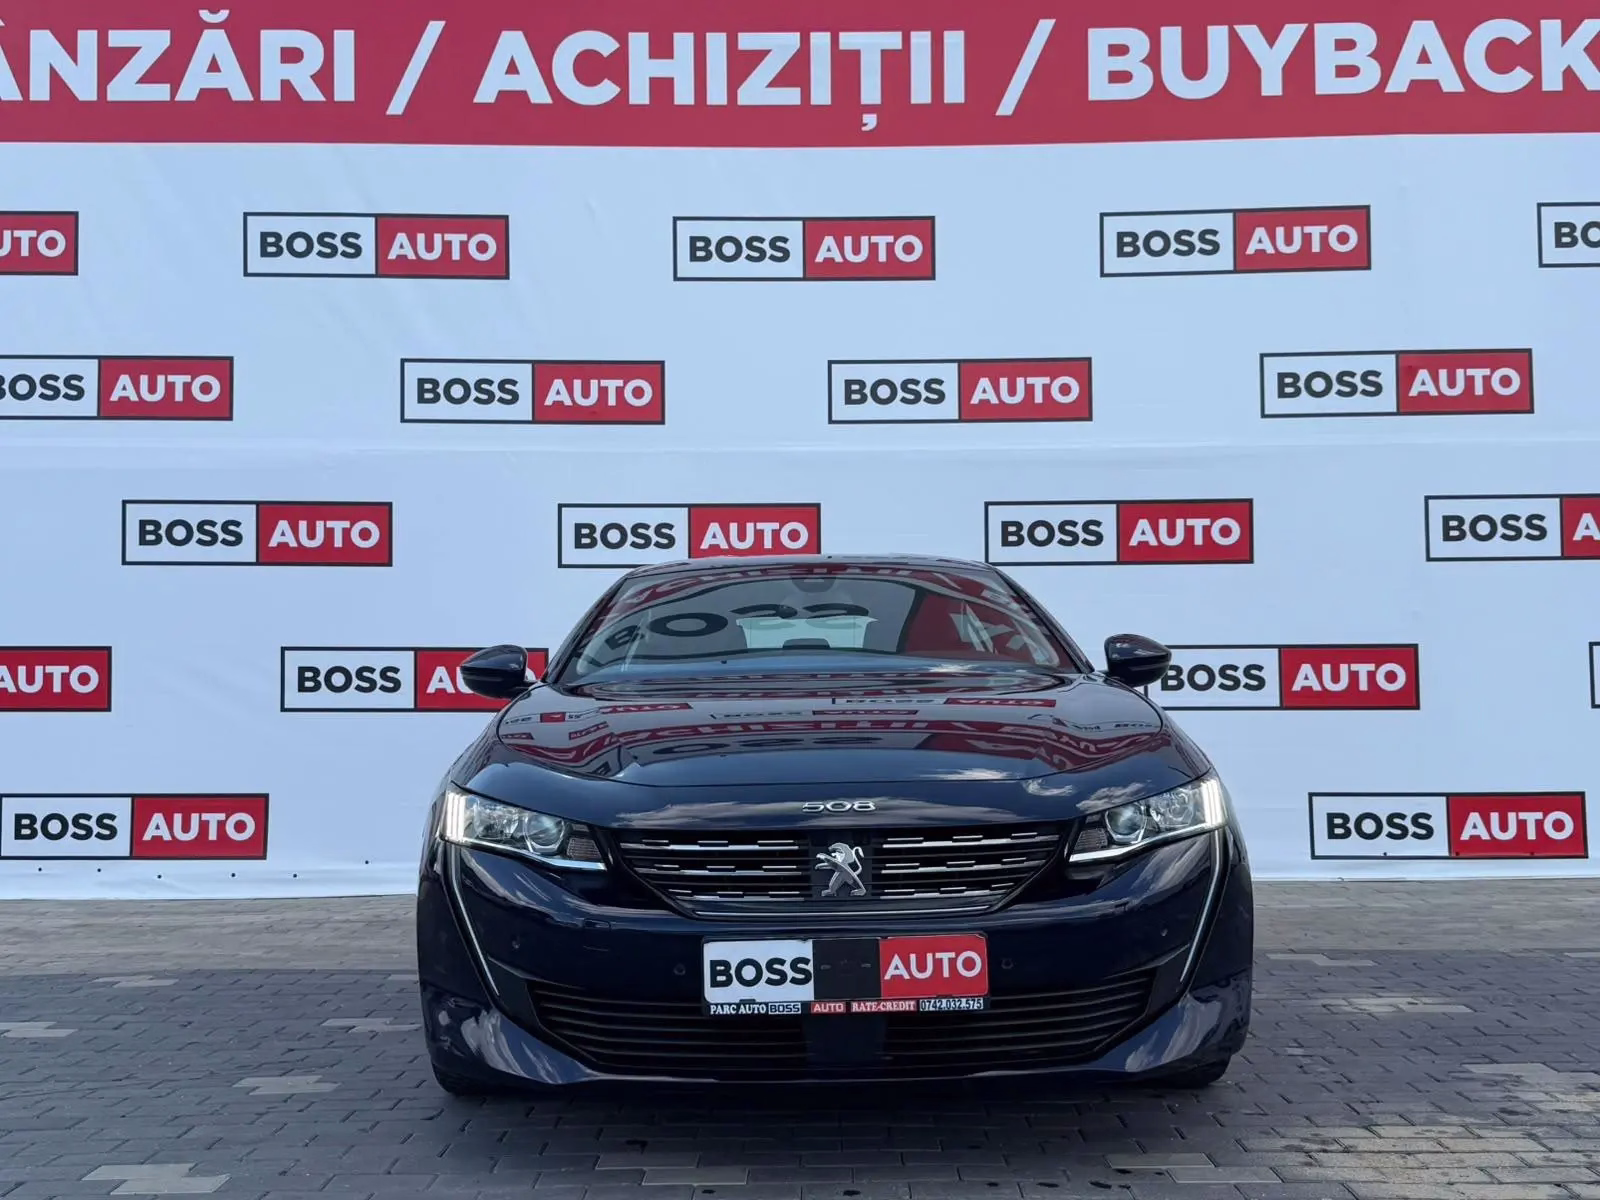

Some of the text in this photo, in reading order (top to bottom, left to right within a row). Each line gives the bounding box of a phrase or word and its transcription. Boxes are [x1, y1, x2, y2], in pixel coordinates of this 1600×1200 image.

[386, 21, 445, 115] /
[474, 31, 964, 130] ACHIZIȚII
[996, 19, 1056, 115] /
[1088, 19, 1600, 100] BUYBACK
[260, 232, 496, 261] BOSS AUTO
[690, 235, 923, 262] BOSS AUTO
[1117, 225, 1358, 258] BOSS AUTO
[0, 374, 220, 402] OSS AUTO
[417, 378, 652, 406] BOSS AUTO
[845, 376, 1079, 405] BOSS AUTO
[1277, 368, 1520, 398] BOSS AUTO
[139, 519, 380, 548] BOSS AUTO
[575, 522, 808, 549] BOSS AUTO
[1001, 518, 1240, 547] BOSS AUTO
[1442, 514, 1547, 541] BOSS
[298, 666, 401, 693] BOSS
[1160, 663, 1406, 692] BOSS AUTO
[802, 800, 876, 812] 508
[14, 813, 255, 841] BOSS AUTO
[1327, 811, 1574, 840] BOSS AUTO
[710, 951, 981, 988] BOSS AUTO
[710, 998, 982, 1015] PARC AUTO BOSS AUTO RATE-CREDIT 0742.032.575
